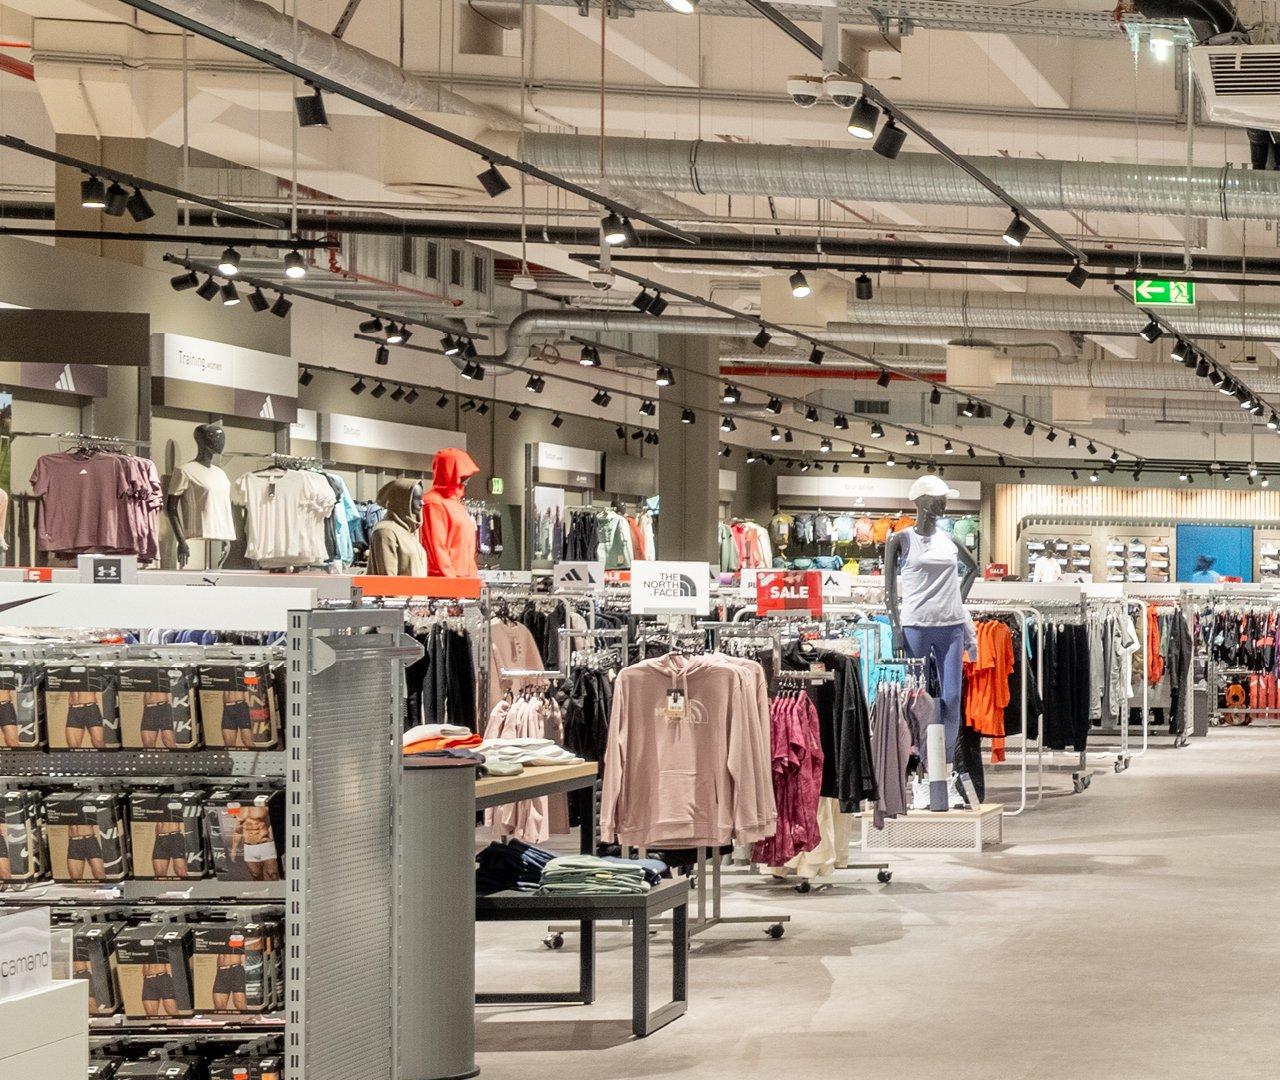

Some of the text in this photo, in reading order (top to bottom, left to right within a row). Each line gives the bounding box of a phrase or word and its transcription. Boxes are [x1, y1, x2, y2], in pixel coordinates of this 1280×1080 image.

[178, 350, 206, 372] Training
[660, 572, 679, 581] THE
[643, 581, 679, 589] NORTH
[653, 588, 679, 597] FACE
[769, 585, 809, 599] SALE
[1, 951, 49, 978] camano
